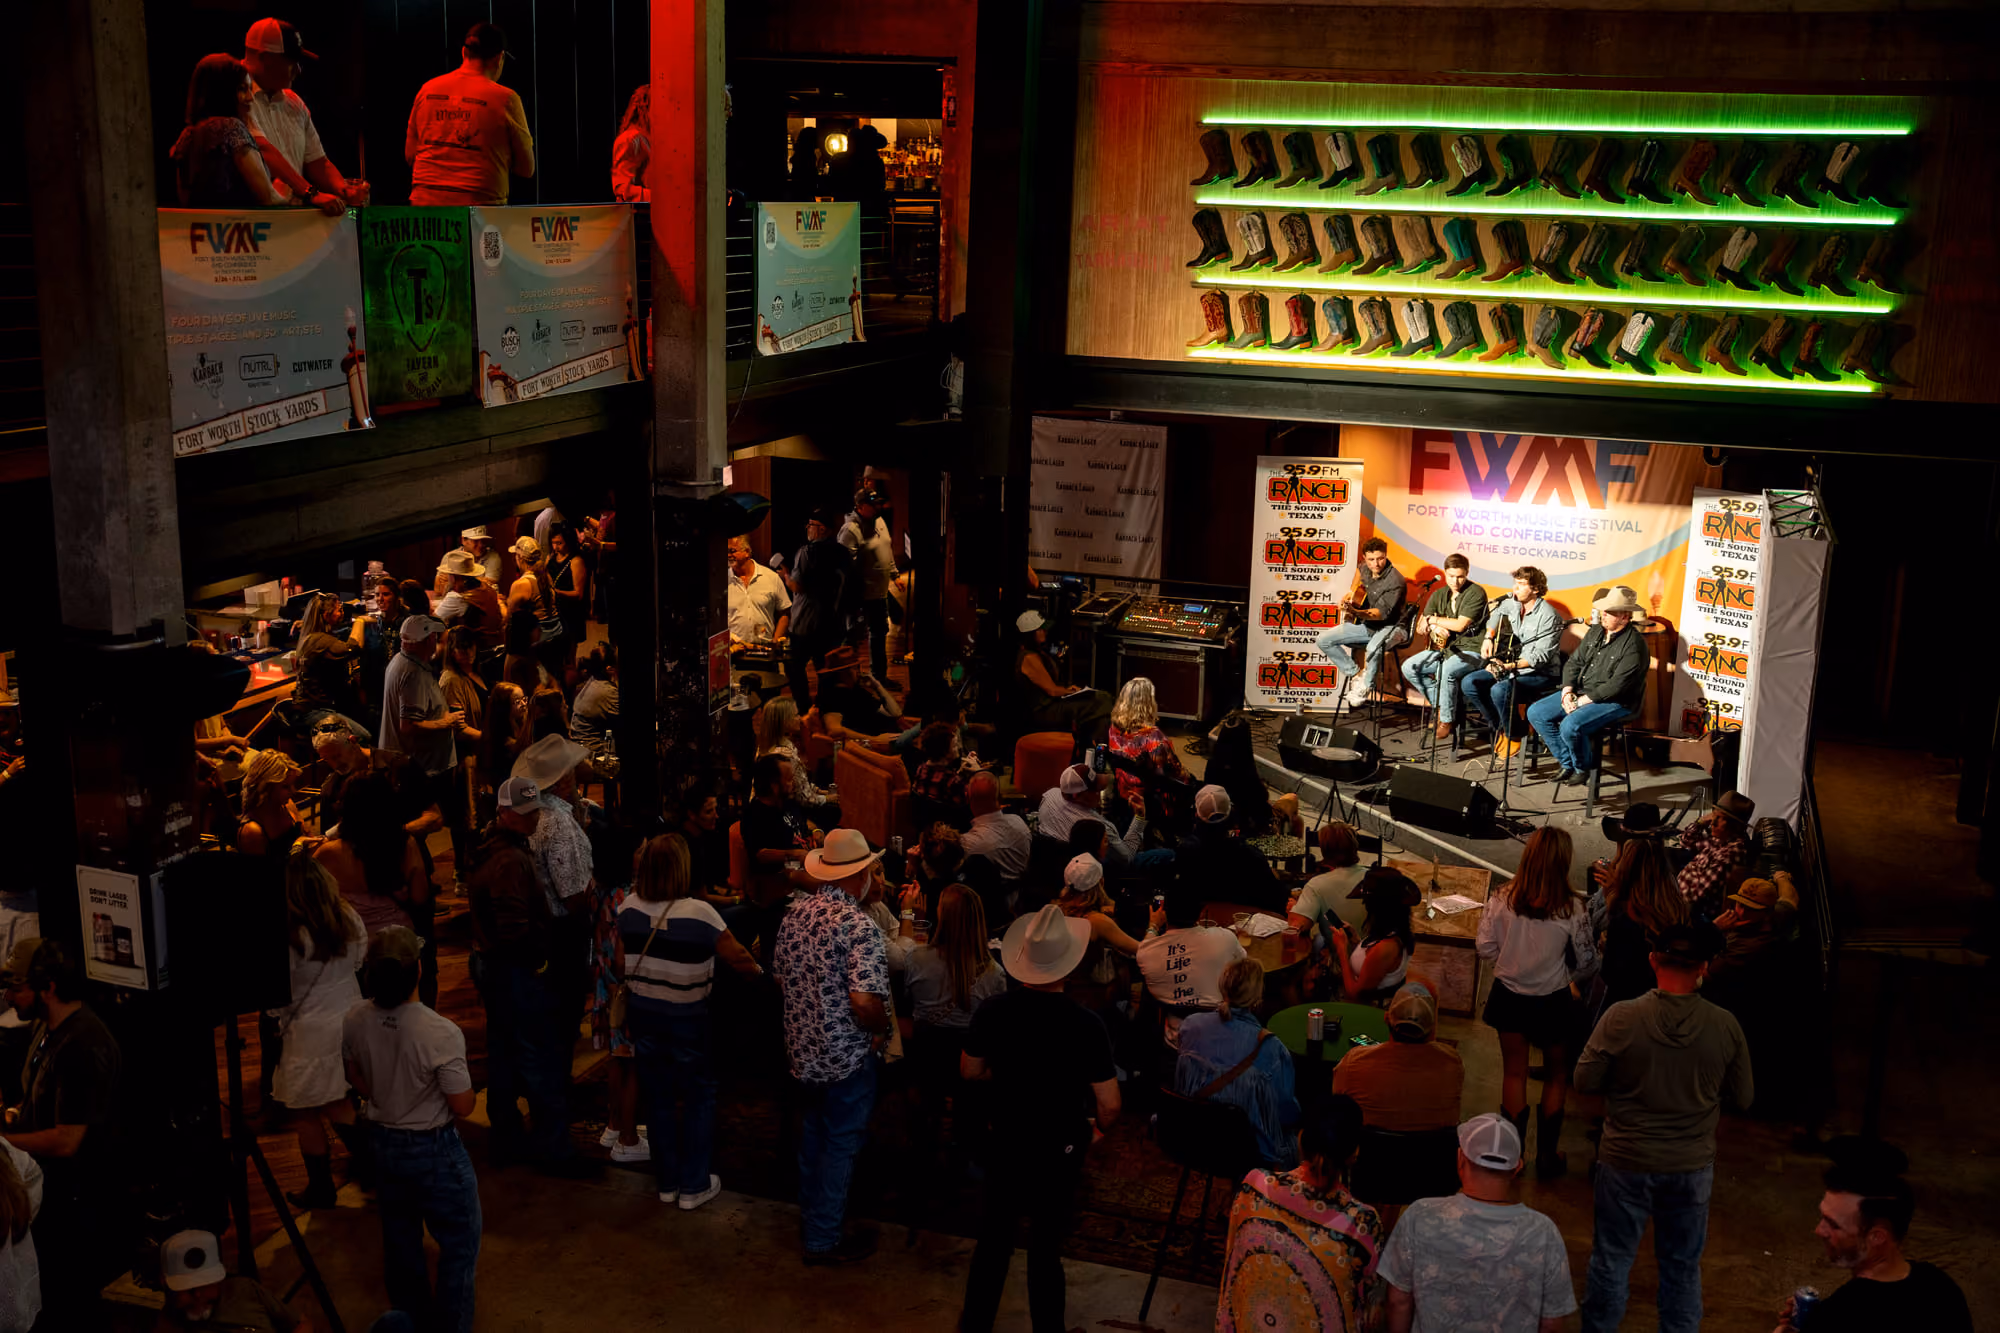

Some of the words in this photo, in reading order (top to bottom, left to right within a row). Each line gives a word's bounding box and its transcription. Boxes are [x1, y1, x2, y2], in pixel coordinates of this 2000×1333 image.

[796, 210, 827, 231] FWMF
[370, 217, 462, 247] TANNAHILL'S
[531, 216, 580, 242] FWMF
[190, 222, 272, 254] FWMF
[171, 316, 200, 327] FOUR
[202, 315, 234, 326] DAYS
[235, 313, 247, 324] OF
[248, 312, 269, 322] LIVE
[270, 310, 297, 320] MUSIC
[167, 334, 194, 344] TIPLE
[195, 331, 237, 344] STAGES
[283, 324, 322, 335] ARTISTS
[592, 324, 617, 336] CUTWATER
[501, 335, 520, 348] BUSCH
[292, 359, 334, 374] CUTWATER
[407, 355, 439, 371] TAVERN
[192, 361, 224, 384] KARBACH
[522, 384, 538, 400] FORT
[540, 372, 562, 389] WORTH
[564, 364, 586, 381] STOCK
[587, 355, 610, 372] YARDS
[178, 431, 204, 451] FORT
[208, 419, 242, 441] WORTH
[248, 408, 281, 431] STOCK
[285, 397, 319, 420] YARDS
[1058, 435, 1080, 444] KARBACH
[1081, 436, 1097, 446] LAGER
[1119, 439, 1141, 448] KARBACH
[1142, 440, 1159, 449] LAGER
[1088, 461, 1110, 470] KARBACH
[1110, 462, 1127, 471] LAGER
[1283, 464, 1322, 476] 95.9
[1322, 467, 1340, 476] FM
[1409, 428, 1649, 510] FWMF
[1055, 481, 1077, 491] KARBACH
[1078, 482, 1095, 492] LAGER
[1271, 478, 1347, 501] RANCH
[1086, 507, 1108, 517] KARBACH
[1109, 508, 1125, 518] LAGER
[1718, 498, 1757, 513] 95.9
[1758, 504, 1763, 514] F
[1407, 504, 1449, 517] FORT
[1454, 507, 1511, 522] WORTH
[1516, 513, 1565, 528] MUSIC
[1570, 516, 1643, 533] FESTIVAL
[1054, 528, 1077, 537] KARBACH
[1077, 529, 1093, 539] LAGER
[1280, 527, 1317, 538] 95.9
[1318, 529, 1336, 538] FM
[1450, 522, 1485, 536] AND
[1490, 526, 1597, 545] CONFERENCE
[1705, 514, 1761, 540] RANC
[1268, 541, 1343, 563] RANCH
[1457, 542, 1473, 551] AT
[1476, 543, 1499, 554] THE
[1502, 545, 1587, 561] STOCKYARDS
[1704, 539, 1725, 549] THE
[1727, 543, 1759, 554] SOUND
[1720, 550, 1757, 562] TEXAS
[1711, 565, 1749, 580] 95.9
[1750, 572, 1757, 581] F
[1276, 590, 1314, 601] 95.9
[1314, 592, 1332, 601] FM
[1699, 581, 1754, 607] RANC
[1264, 604, 1339, 626] RANCH
[1697, 605, 1718, 614] THE
[1720, 609, 1753, 621] SOUND
[1713, 616, 1748, 629] TEXAS
[1704, 632, 1741, 647] 95.9
[1741, 640, 1749, 650] F
[1272, 651, 1310, 662] 95.9
[1310, 653, 1328, 662] FM
[1691, 647, 1748, 674] RANC
[1261, 665, 1335, 687] RANCH
[1690, 672, 1709, 681] THE
[1712, 676, 1745, 689] SOUND
[1706, 682, 1741, 696] TEXAS
[1697, 697, 1734, 713] 95.9
[1734, 705, 1742, 715] F
[89, 887, 107, 897] DRINK
[1167, 944, 1186, 956] It's
[1166, 957, 1191, 971] Life
[1174, 974, 1187, 984] to
[1174, 987, 1194, 999] the
